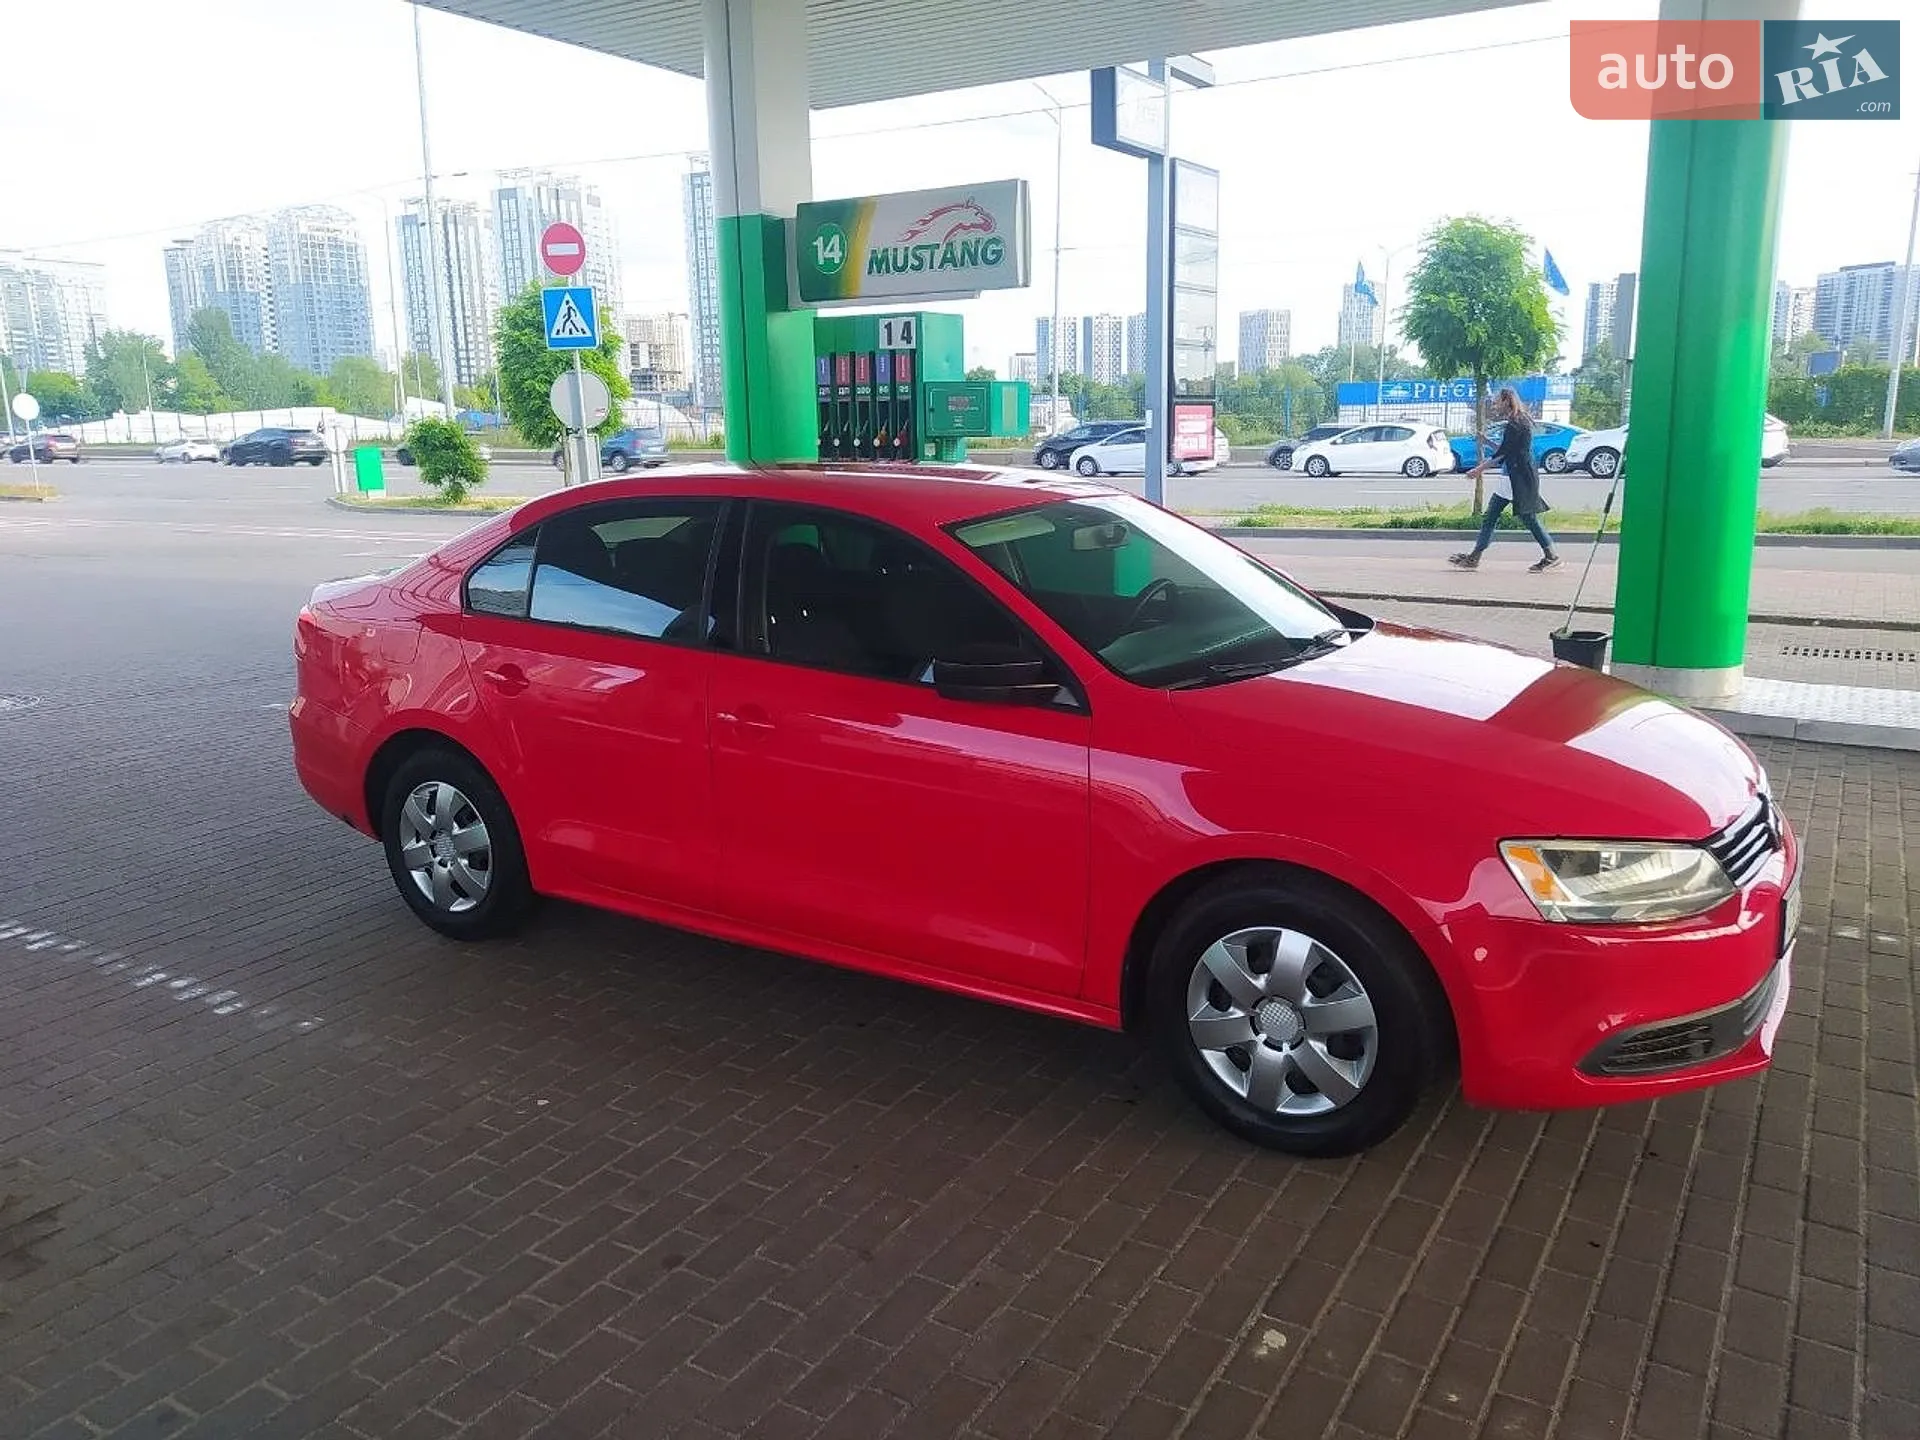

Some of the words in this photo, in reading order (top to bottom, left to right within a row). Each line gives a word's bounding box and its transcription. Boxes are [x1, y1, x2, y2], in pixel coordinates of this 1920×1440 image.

[813, 233, 842, 265] 14
[867, 236, 1005, 275] MUSTANG
[883, 320, 912, 346] 14
